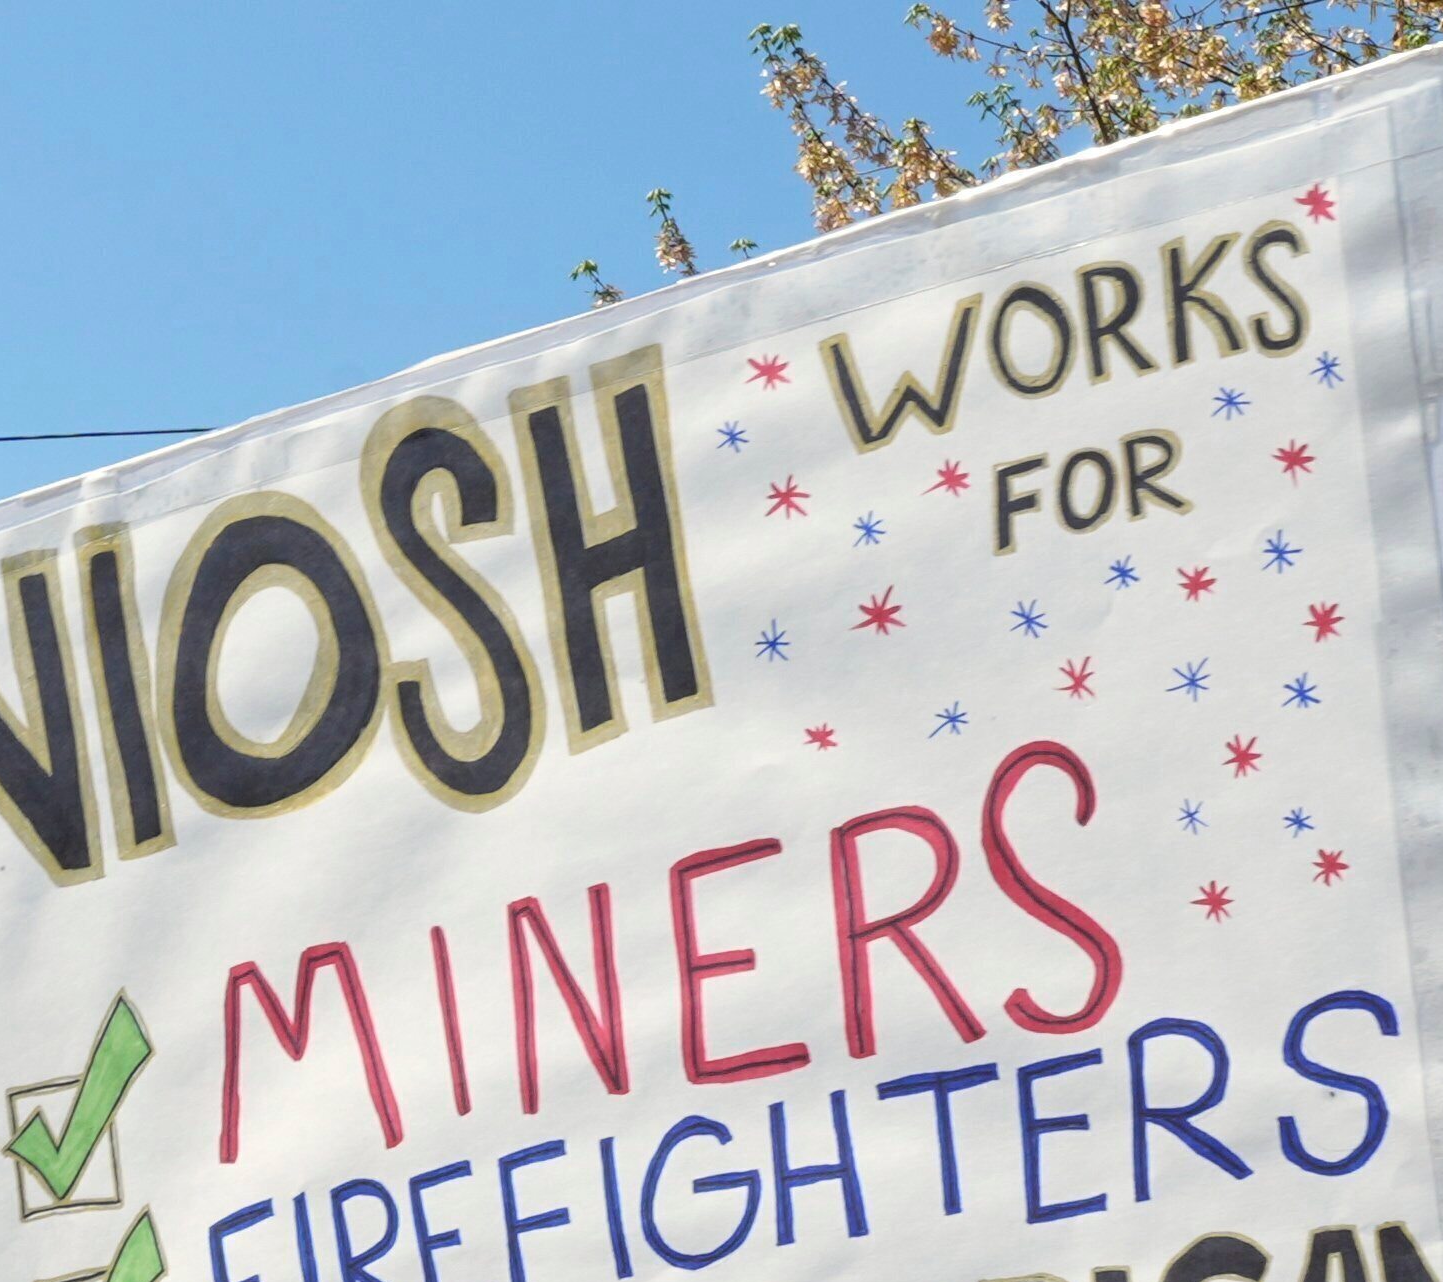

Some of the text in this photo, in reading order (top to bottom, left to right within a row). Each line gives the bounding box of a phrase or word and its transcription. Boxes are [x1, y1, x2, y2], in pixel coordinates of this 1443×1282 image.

[820, 221, 1312, 454] WORKS
[991, 429, 1193, 556] FOR
[218, 740, 1123, 1163] MINERS
